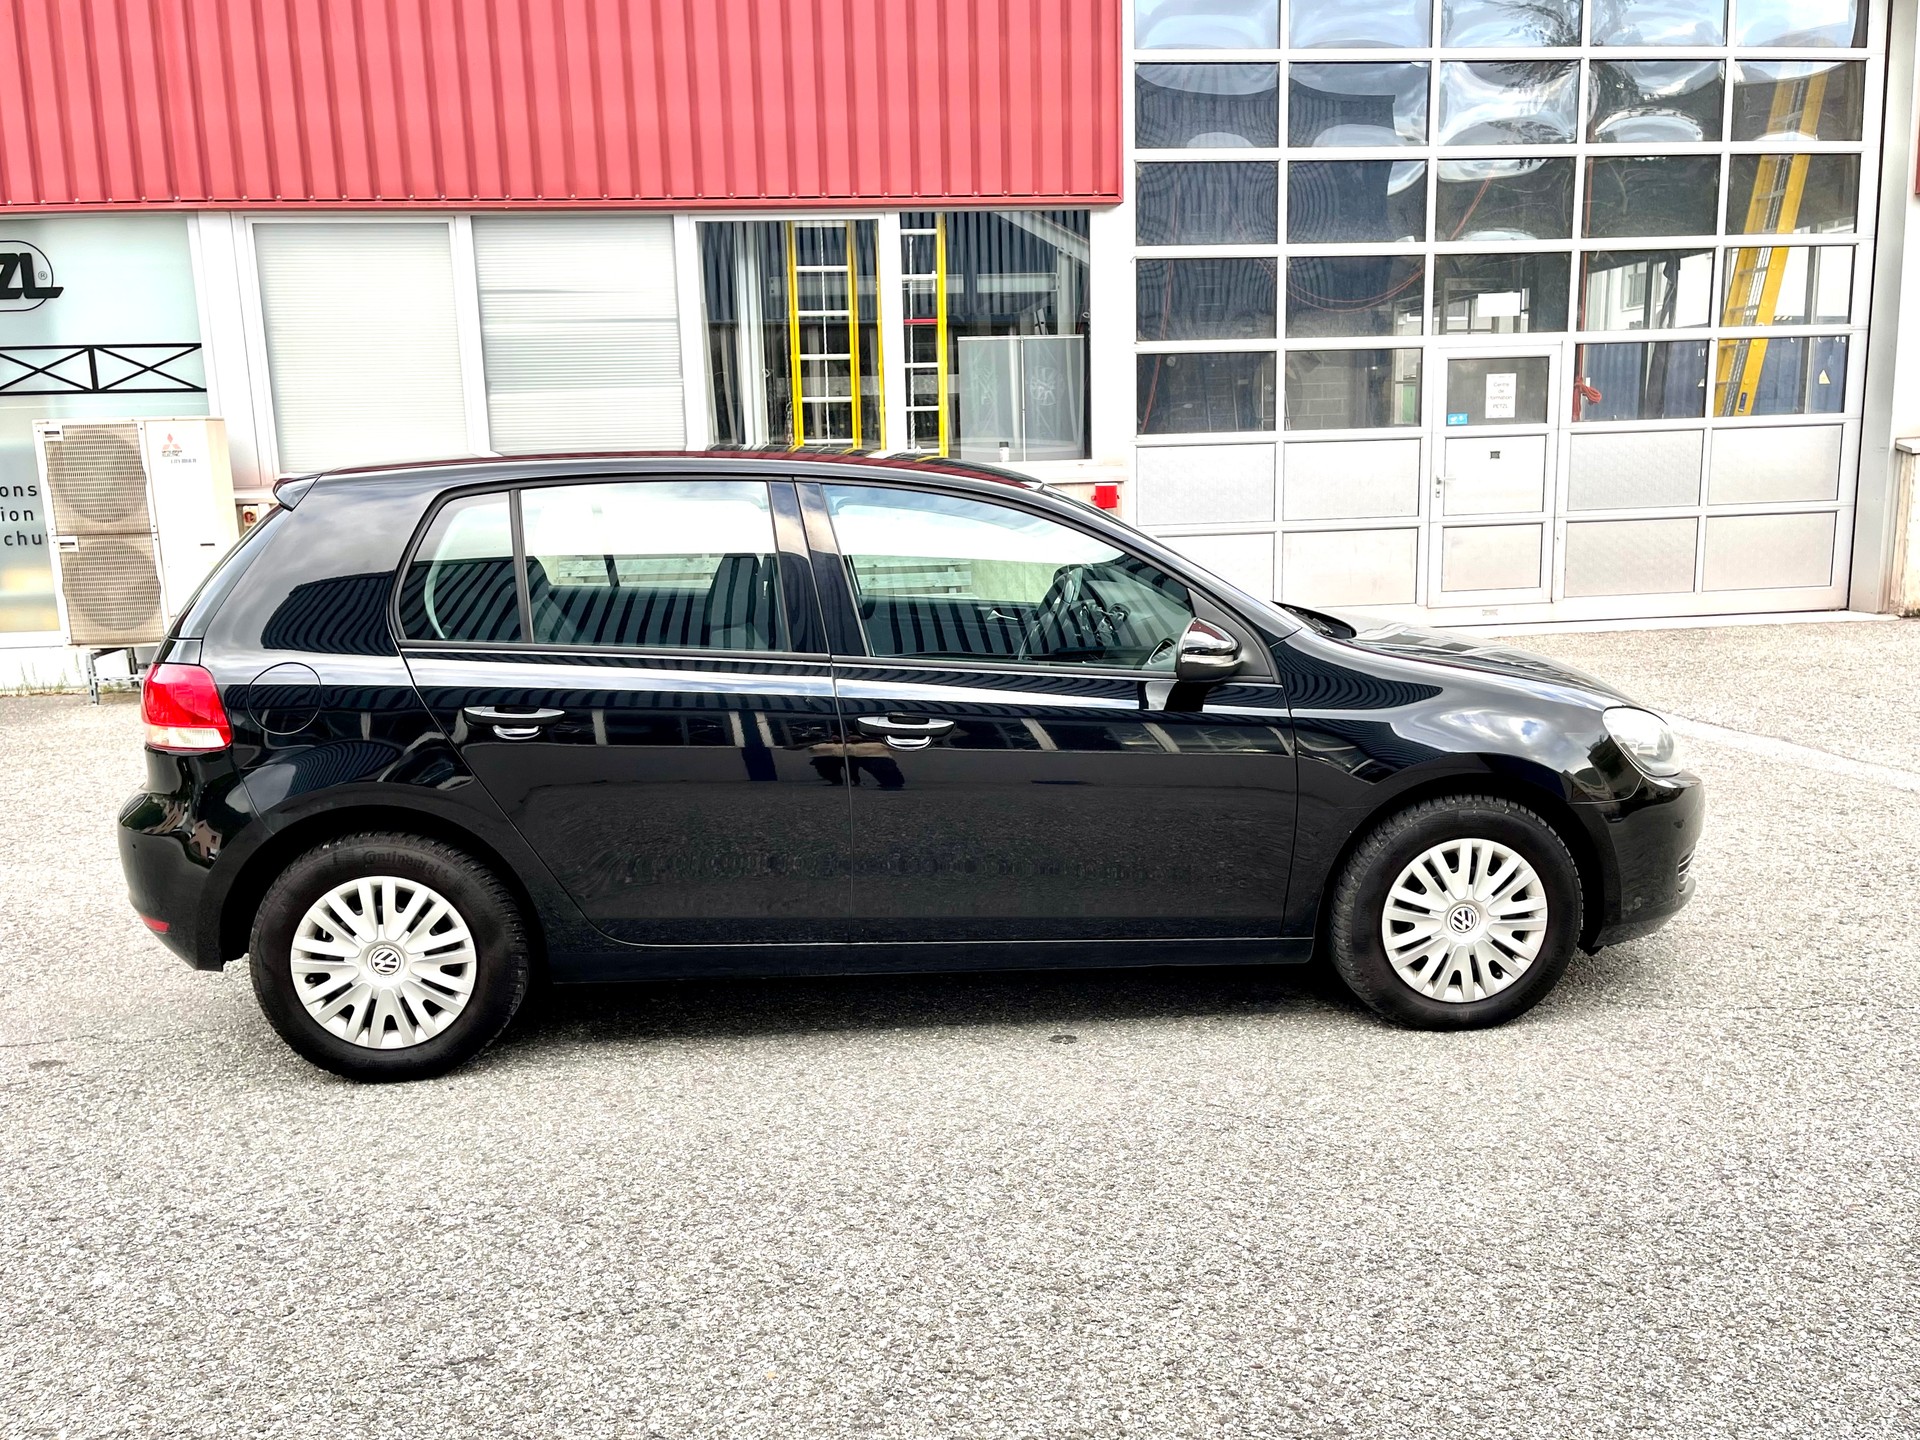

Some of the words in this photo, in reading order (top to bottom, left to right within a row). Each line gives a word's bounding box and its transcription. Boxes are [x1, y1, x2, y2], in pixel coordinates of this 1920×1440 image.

[0, 485, 38, 498] ons
[0, 506, 34, 522] ion
[4, 530, 48, 546] chu
